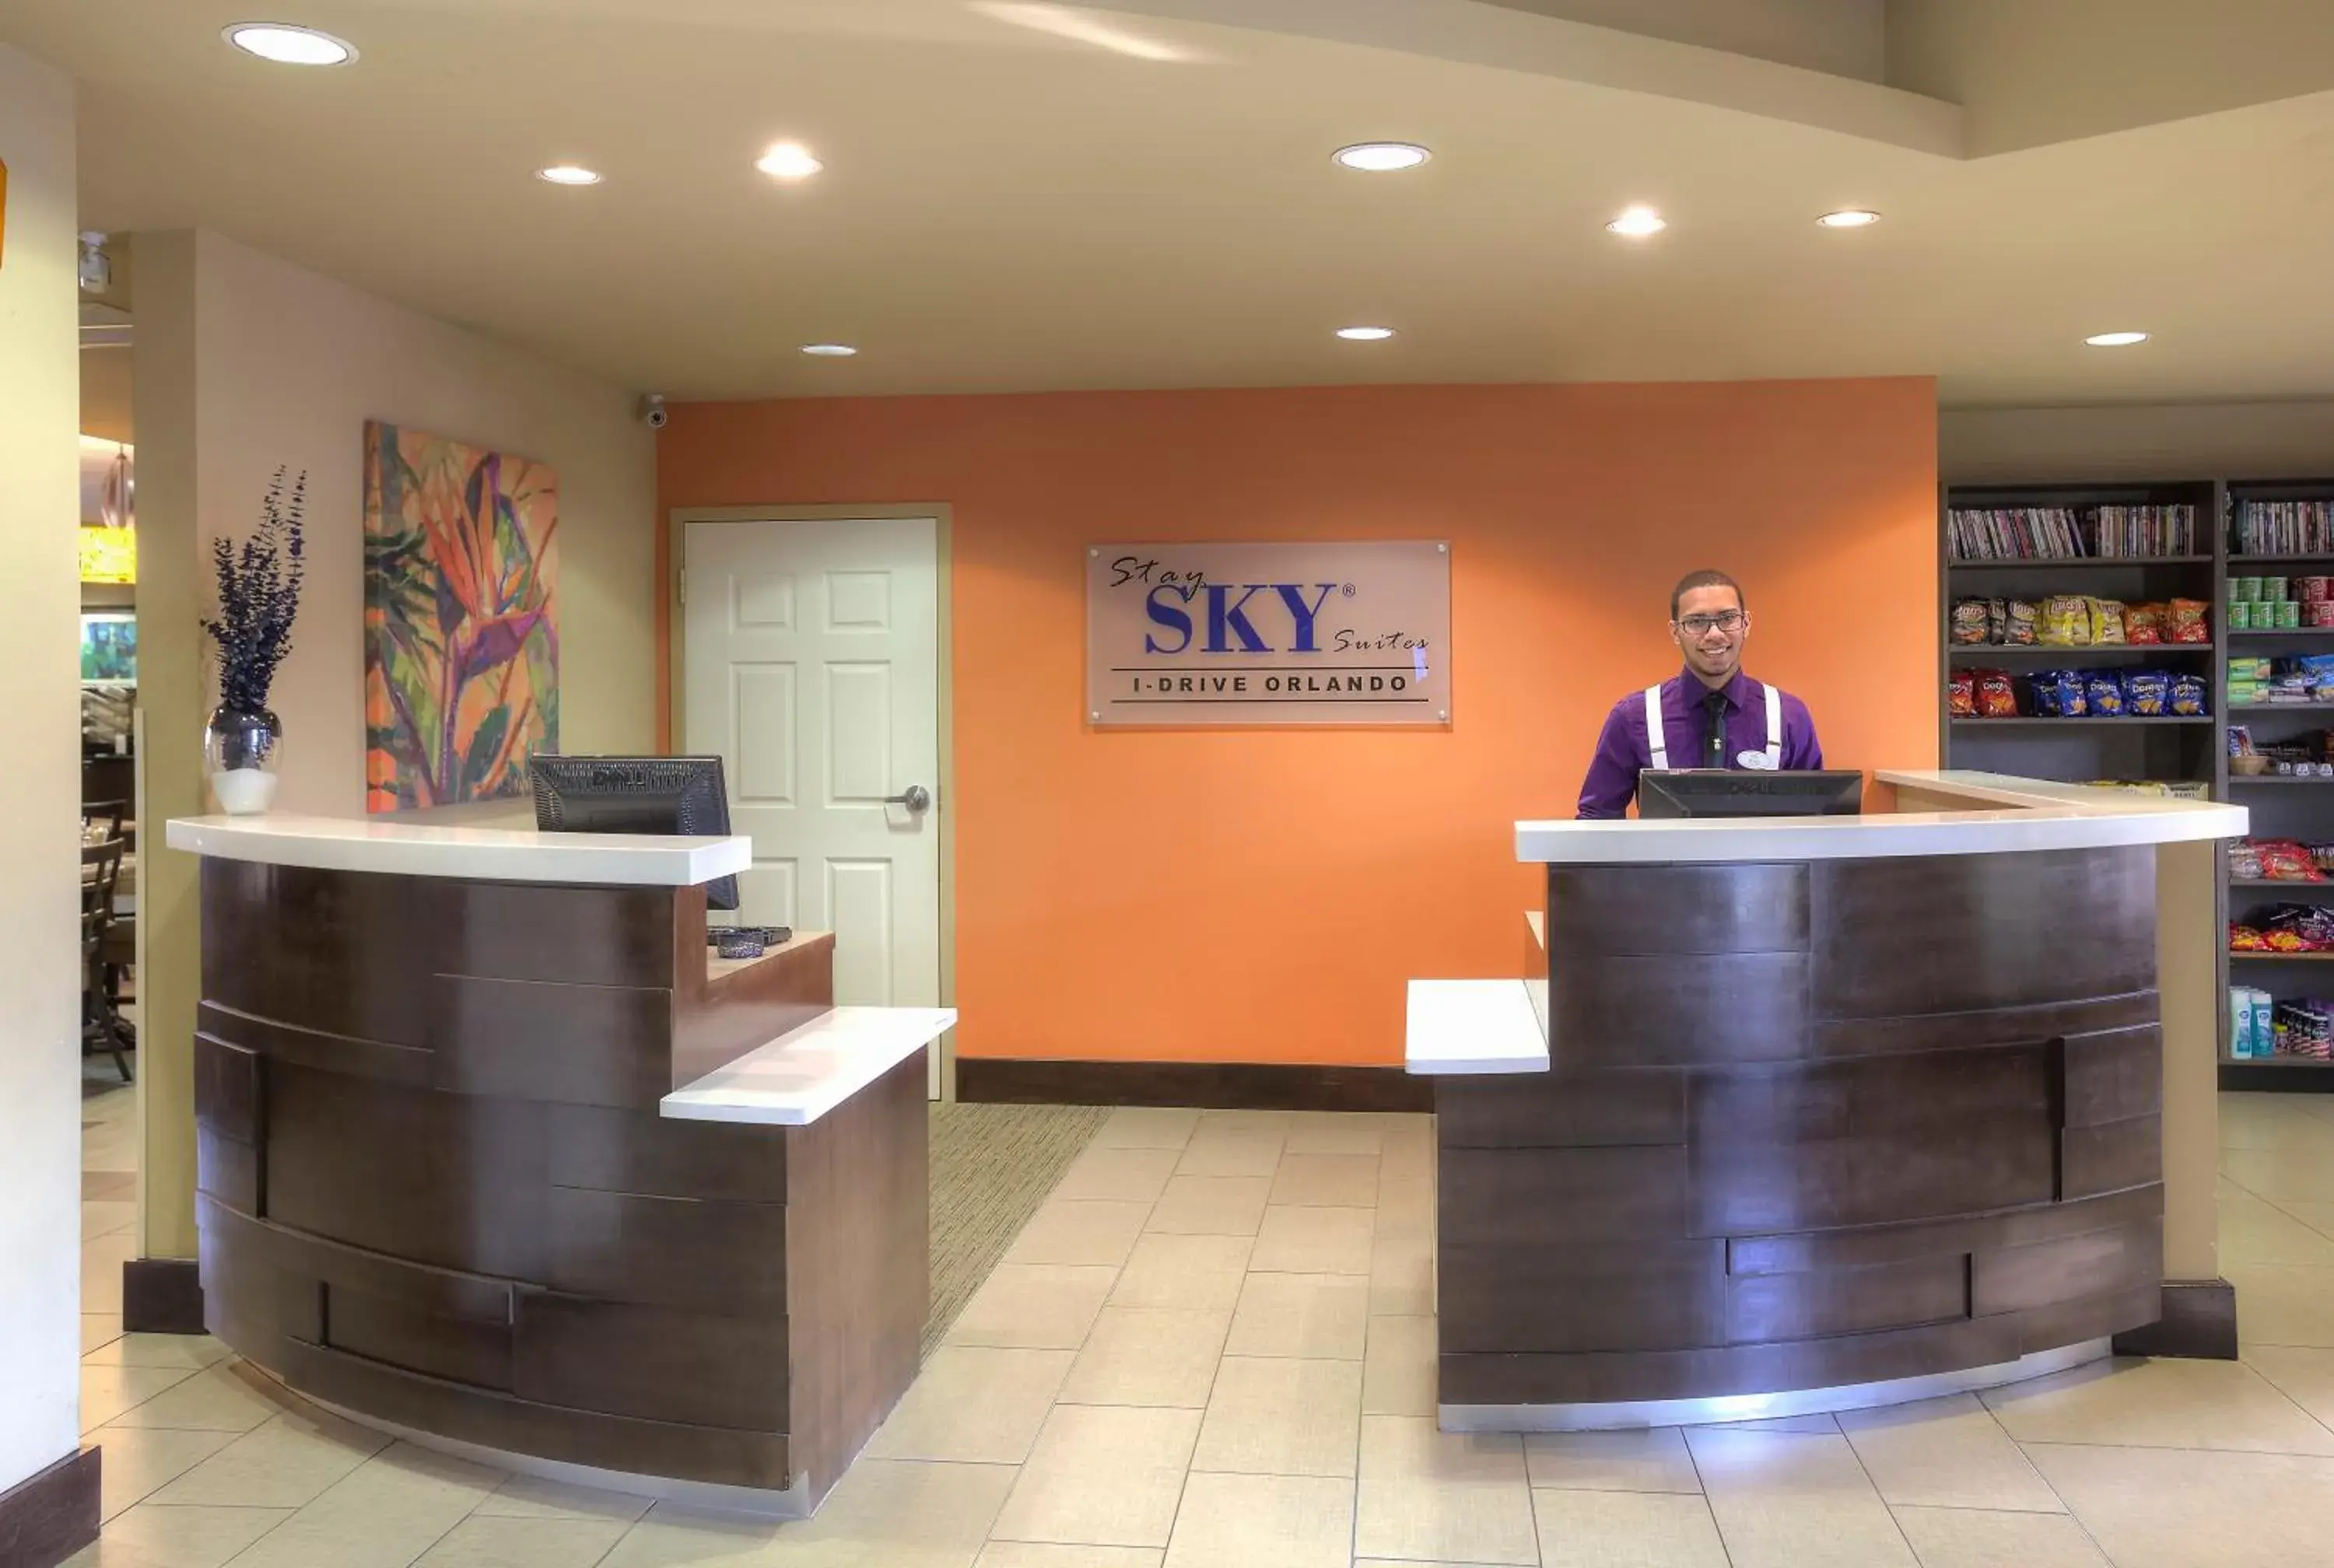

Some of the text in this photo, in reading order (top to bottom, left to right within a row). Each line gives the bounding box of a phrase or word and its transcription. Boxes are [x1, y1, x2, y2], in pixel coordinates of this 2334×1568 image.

[1110, 556, 1206, 604] Stay
[1333, 629, 1428, 653] Suites
[1133, 675, 1407, 691] I-DRIVE ORLANDO
